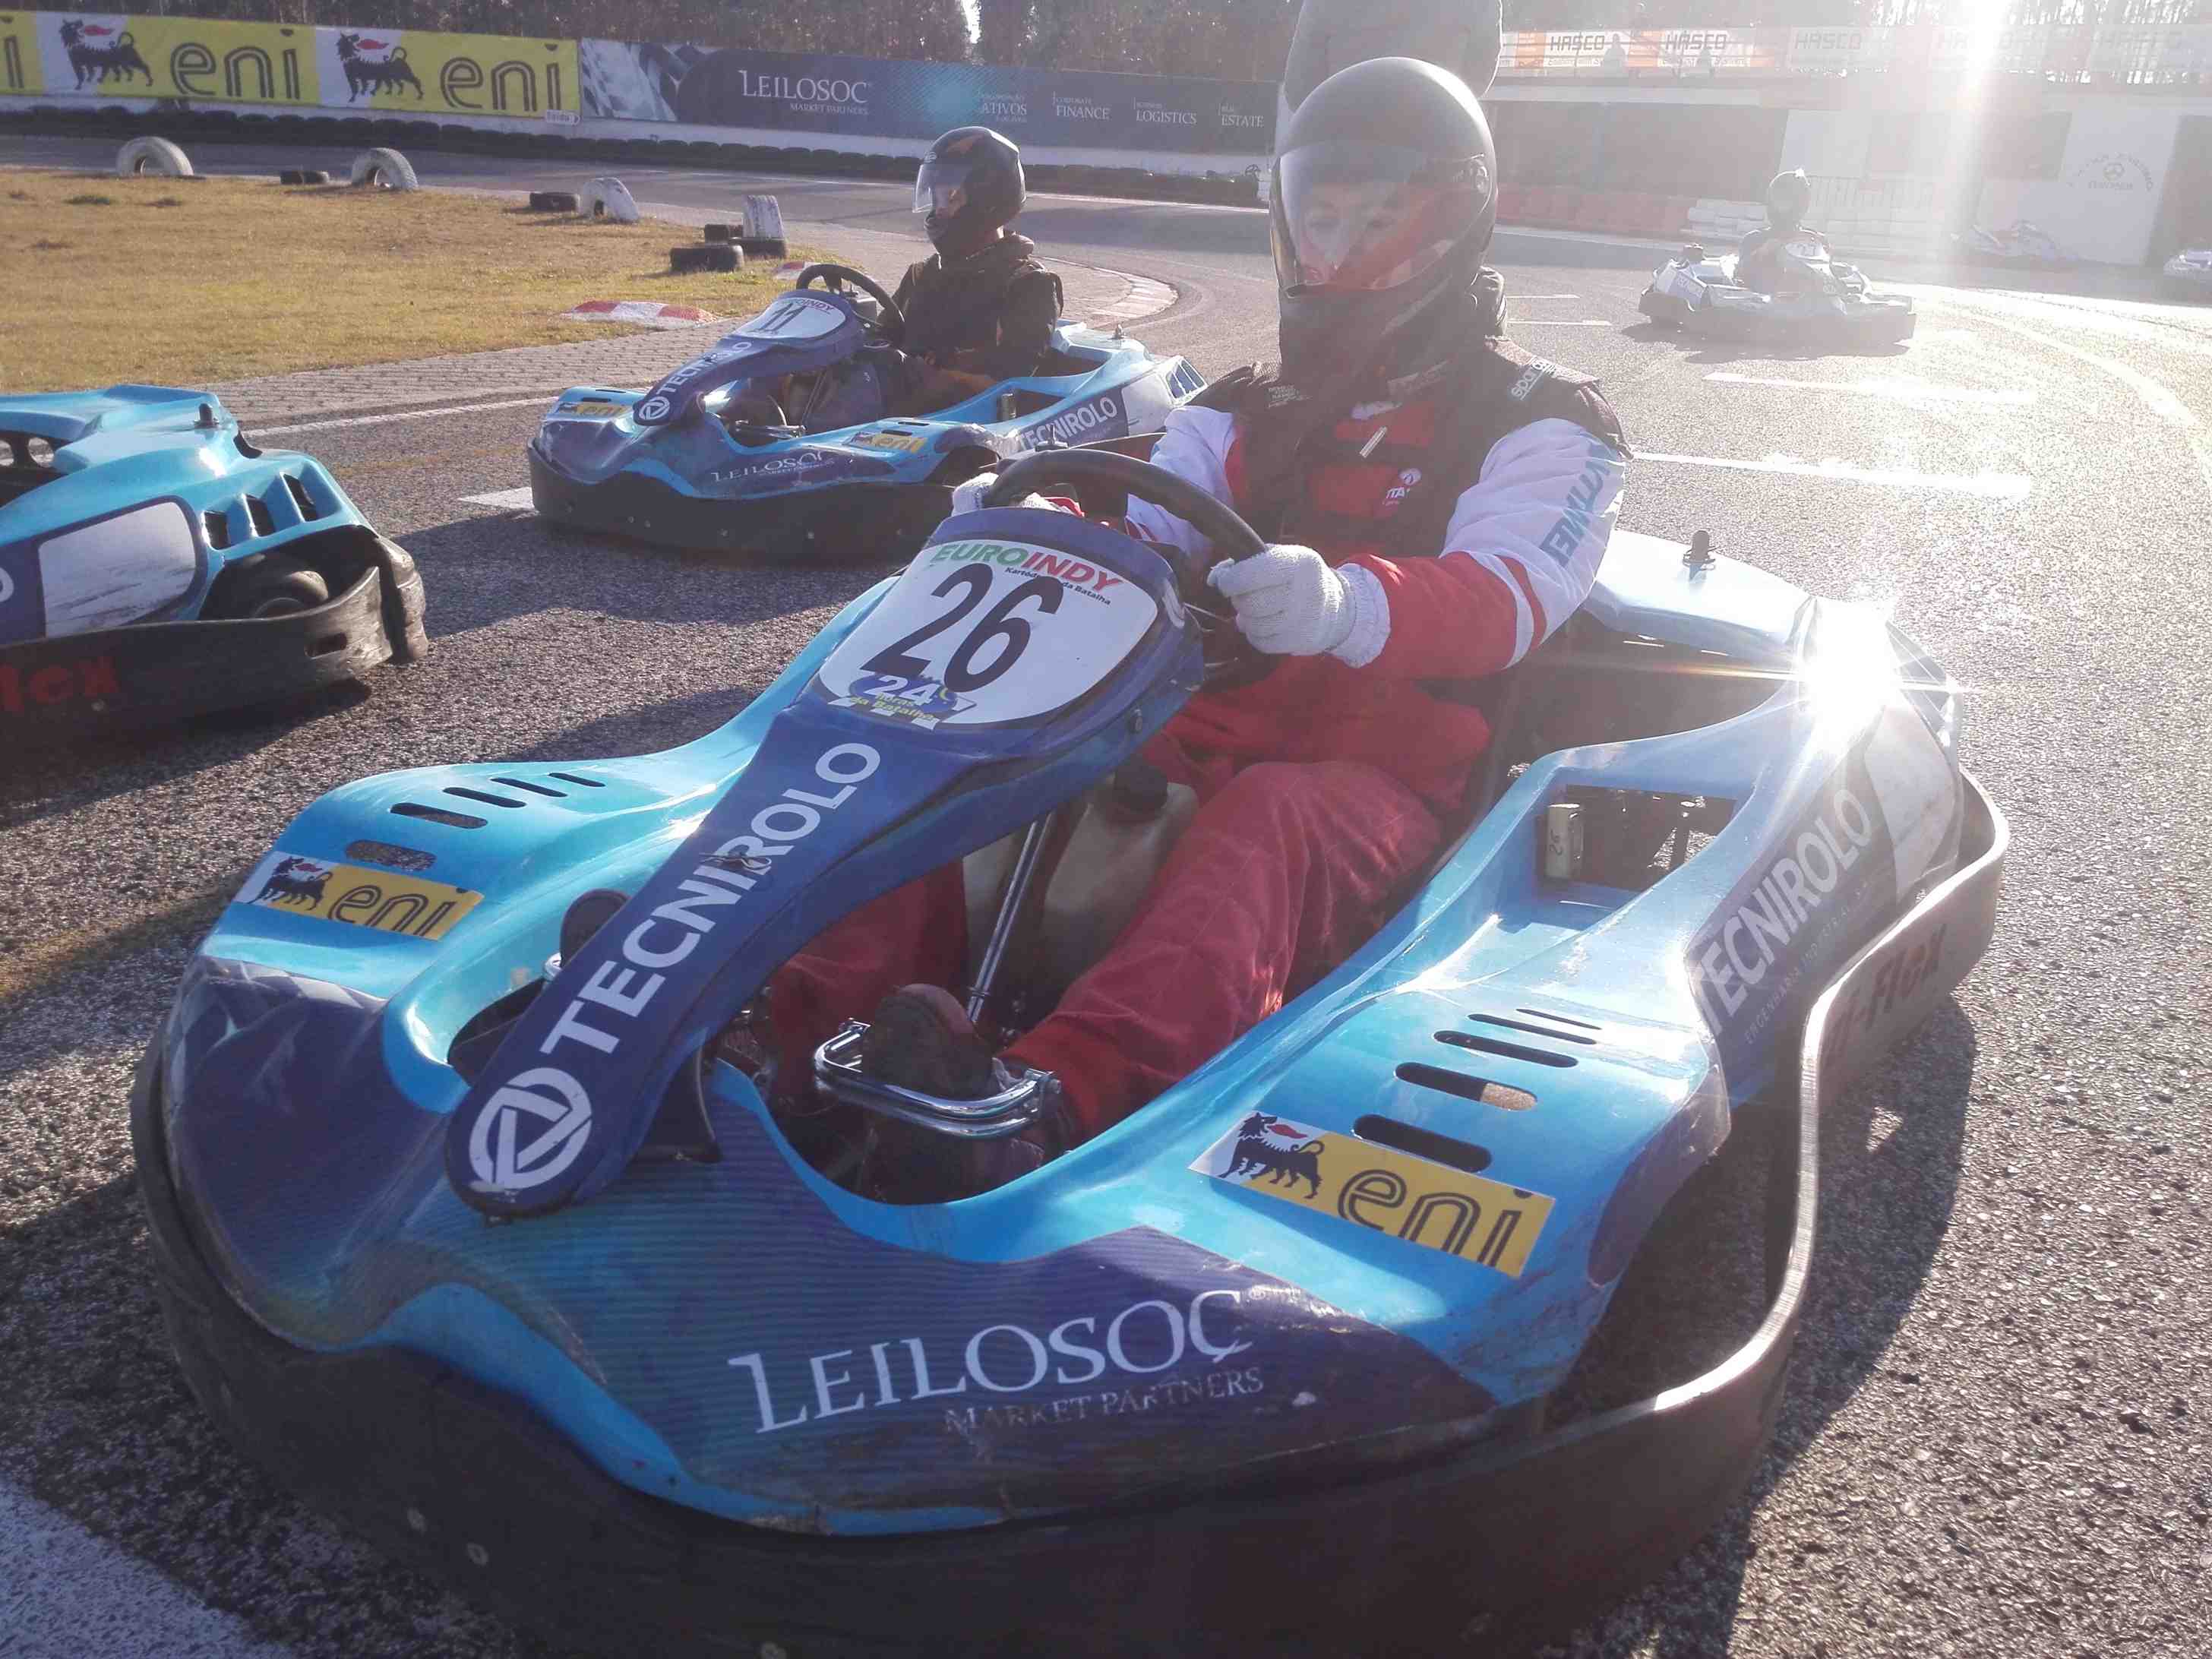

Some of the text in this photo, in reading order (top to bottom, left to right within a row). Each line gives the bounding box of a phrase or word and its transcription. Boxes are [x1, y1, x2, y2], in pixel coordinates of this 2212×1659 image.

[1550, 35, 1605, 51] HASCO
[1665, 33, 1727, 49] HASCO
[169, 28, 301, 100] eni
[439, 43, 562, 112] eni
[736, 69, 868, 103] LEILOSOC
[1056, 104, 1111, 119] FINANCE
[1136, 109, 1197, 125] LOGISTICS
[1221, 115, 1265, 128] ESTATE
[754, 302, 807, 333] 11
[929, 543, 1125, 592] EUROINDY
[1075, 584, 1111, 607] Batalha
[859, 563, 1064, 693] 26
[863, 675, 941, 706] 24
[327, 885, 474, 939] eni
[539, 741, 882, 1055] TECNIROLO
[1692, 788, 1872, 1036] TECNIROLO
[1337, 1166, 1532, 1266] eni
[1101, 1367, 1265, 1418] PARTNERS
